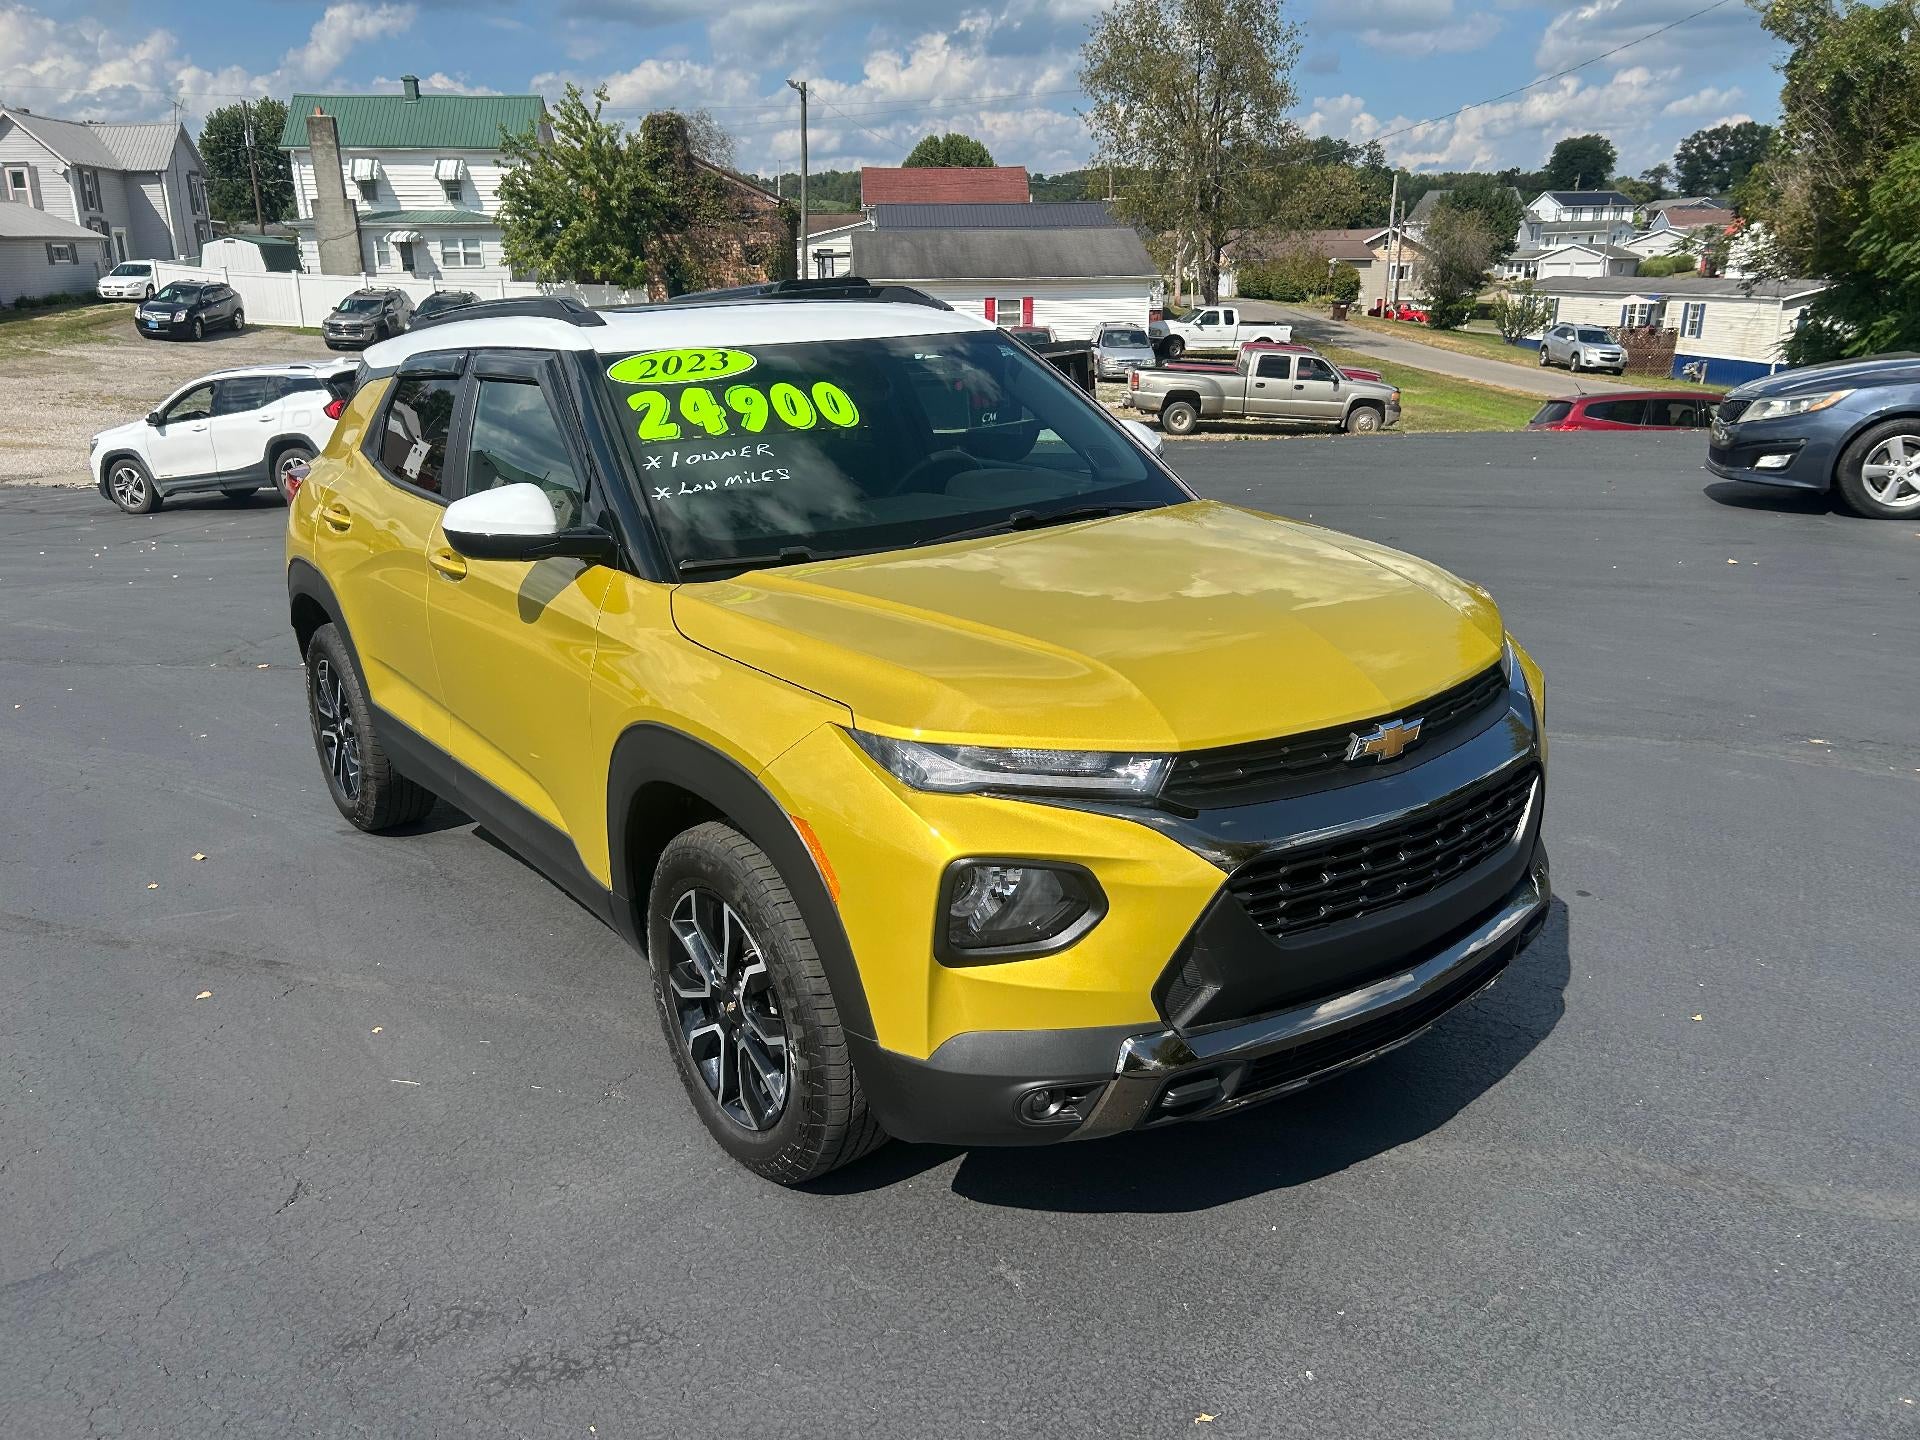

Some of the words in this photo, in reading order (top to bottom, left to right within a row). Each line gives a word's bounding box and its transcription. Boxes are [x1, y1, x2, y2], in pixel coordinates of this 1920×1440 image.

[639, 351, 730, 380] 2023
[626, 381, 860, 441] 24900
[686, 443, 775, 465] OWNER
